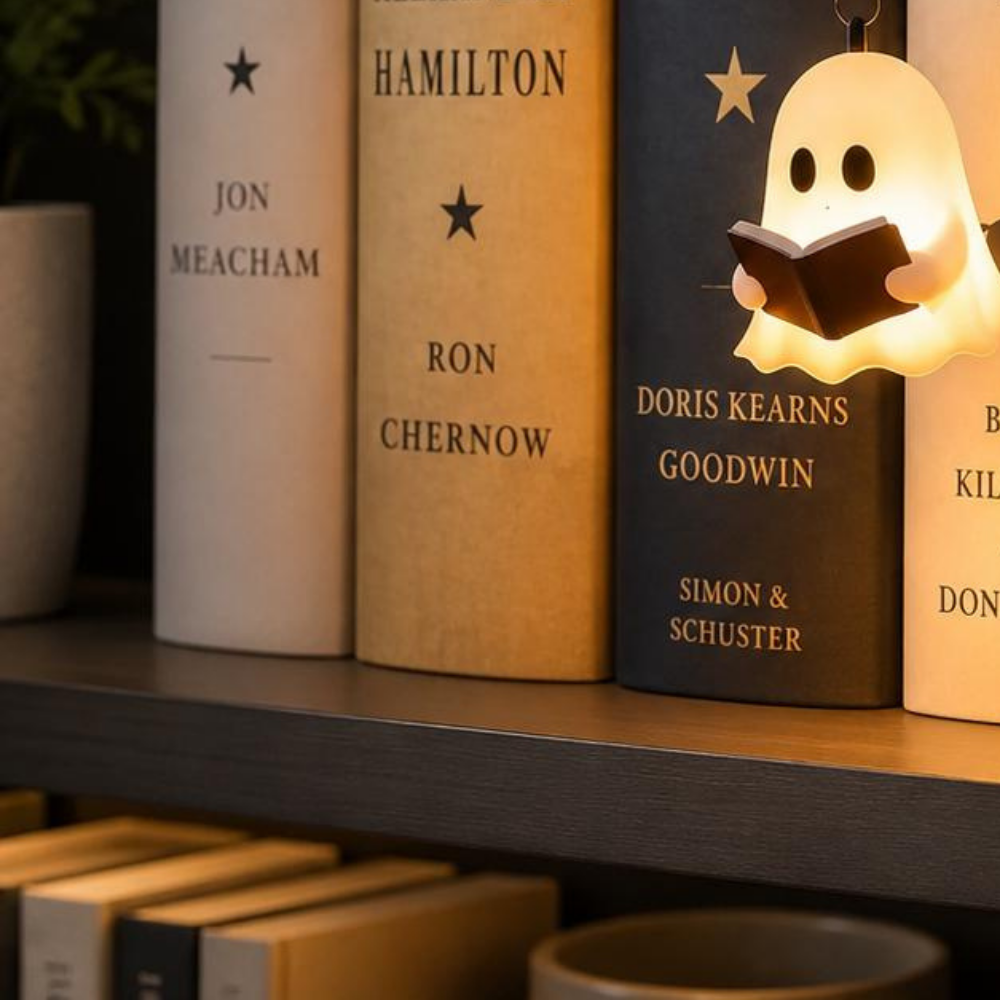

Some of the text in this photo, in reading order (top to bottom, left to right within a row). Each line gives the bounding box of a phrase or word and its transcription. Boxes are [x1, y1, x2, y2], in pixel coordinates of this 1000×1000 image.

[373, 48, 567, 96] HAMILTON
[213, 181, 269, 214] JON
[170, 244, 320, 276] MEACHAM
[427, 341, 497, 373] RON
[636, 385, 849, 425] DORIS KEARNS
[380, 417, 551, 458] CHERNOW
[658, 448, 814, 488] GOODWIN
[679, 577, 789, 609] SIMON &
[937, 585, 1000, 617] DON
[669, 617, 802, 651] SCHUSTER
